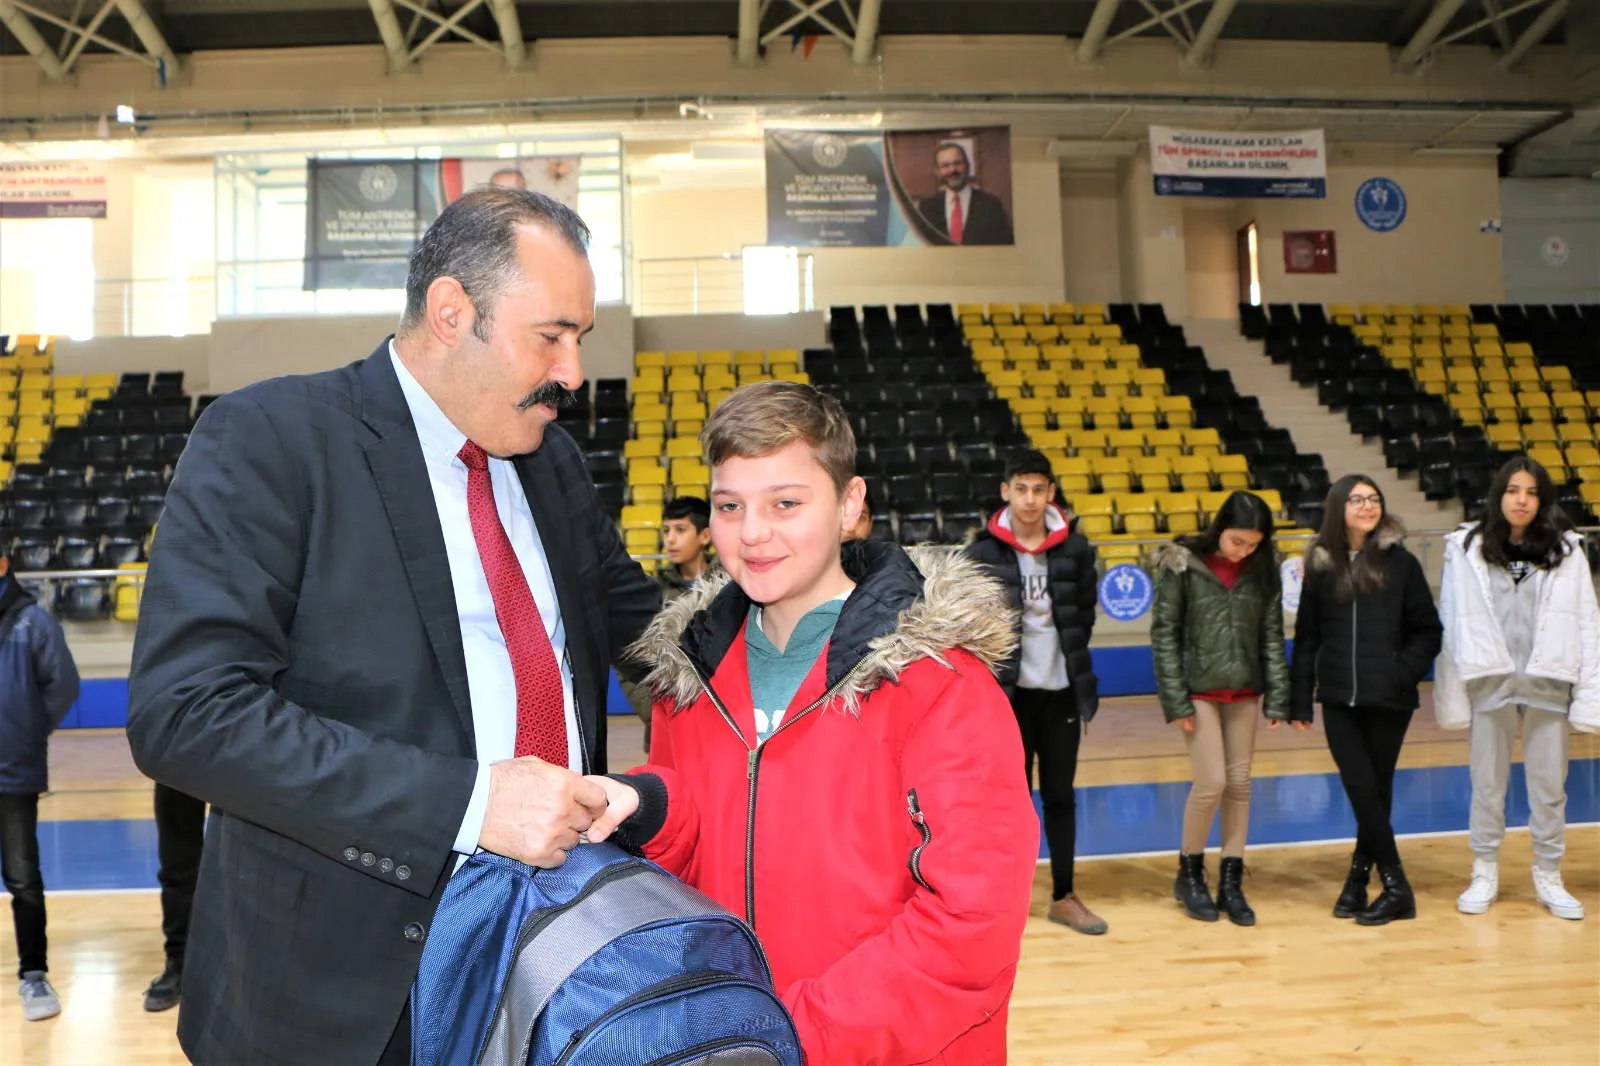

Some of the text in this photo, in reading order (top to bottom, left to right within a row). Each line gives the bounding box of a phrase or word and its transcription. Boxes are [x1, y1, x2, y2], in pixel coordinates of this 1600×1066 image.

[1258, 136, 1303, 147] KATILAN
[1158, 145, 1179, 156] TÜM
[1181, 147, 1222, 158] SPORCU
[1187, 159, 1246, 170] BAŞARILAR
